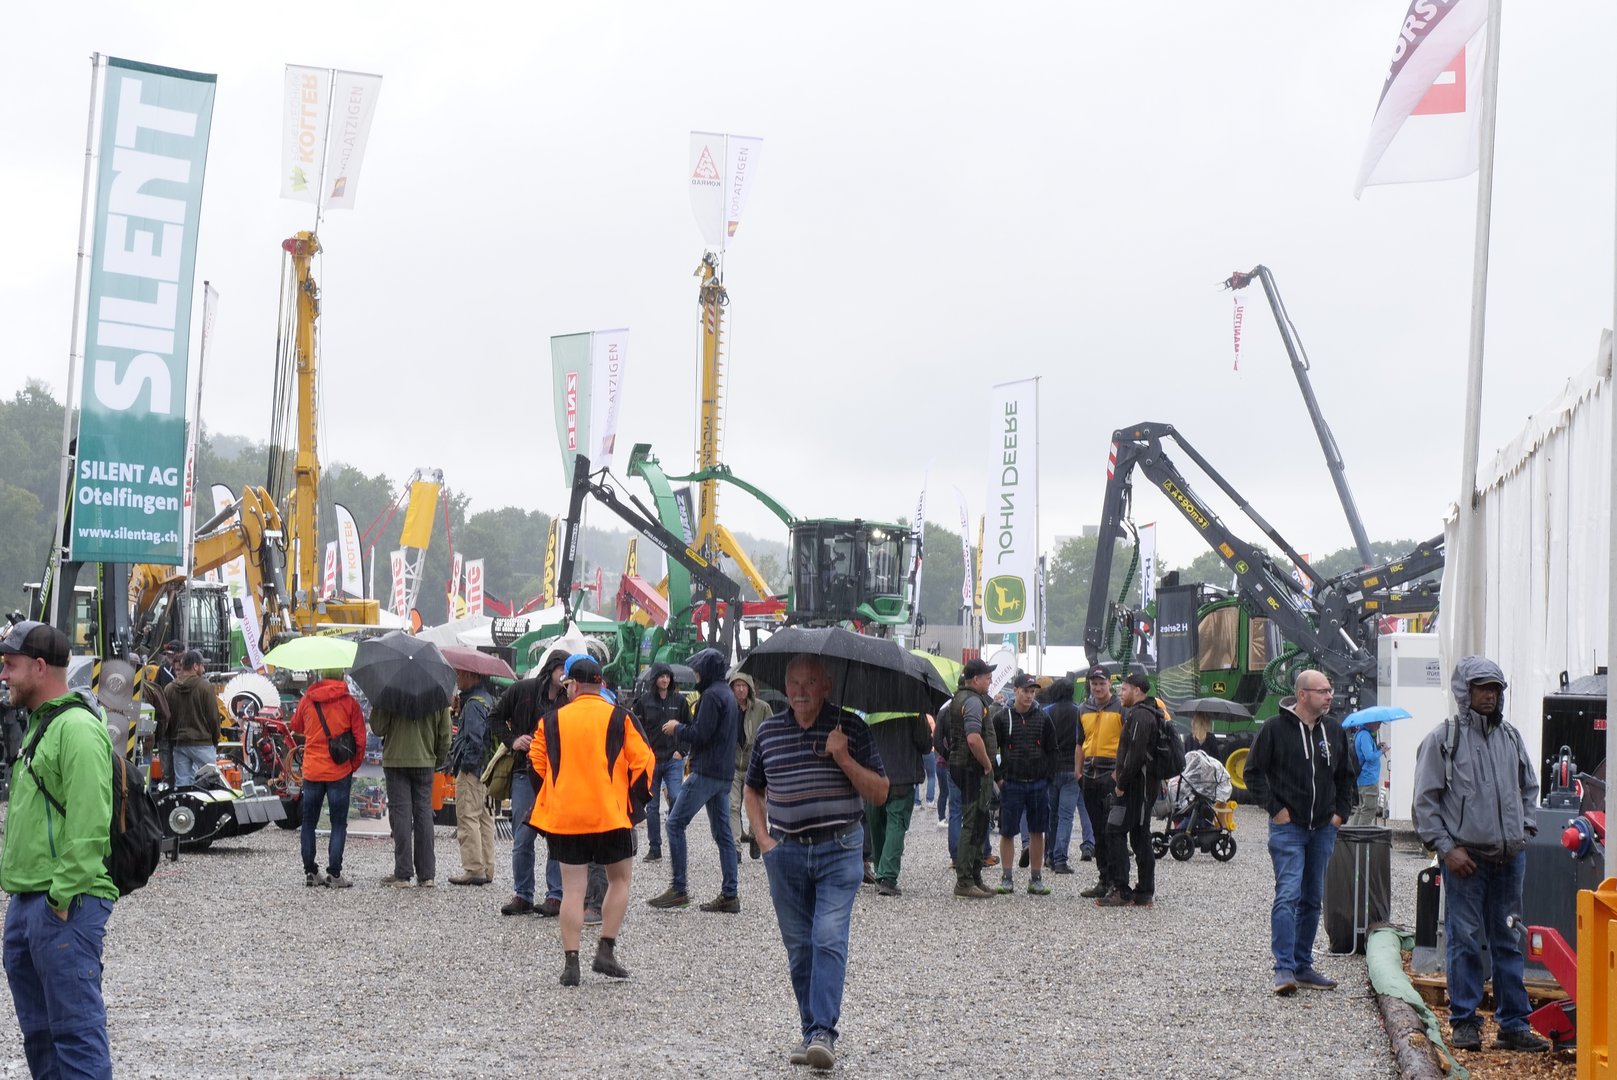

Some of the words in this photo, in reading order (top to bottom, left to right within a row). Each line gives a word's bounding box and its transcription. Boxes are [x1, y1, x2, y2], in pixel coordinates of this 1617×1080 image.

[1386, 0, 1451, 81] ORS
[94, 77, 199, 415] SILENT
[80, 459, 145, 484] SILENT
[149, 467, 178, 487] AG
[79, 486, 178, 515] Otelfingen
[78, 527, 178, 545] www.silentag.ch
[40, 566, 50, 604] HYBRID
